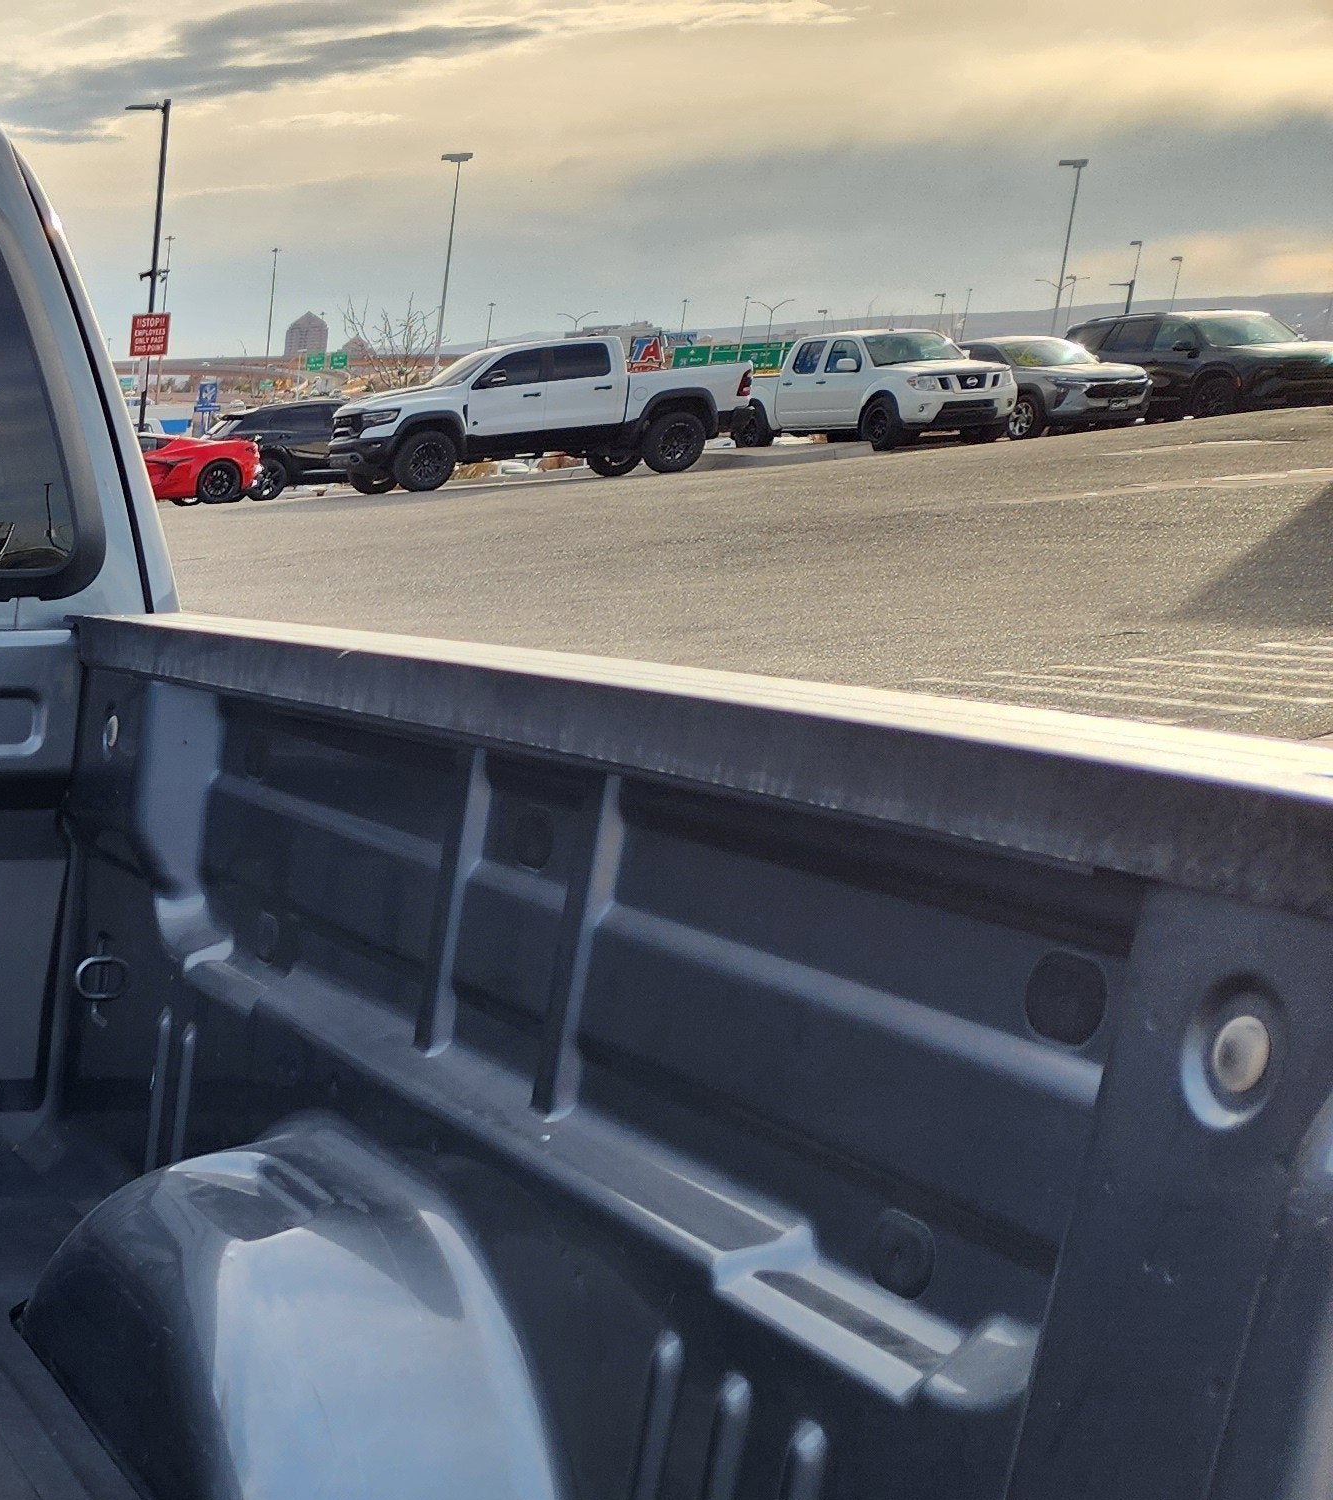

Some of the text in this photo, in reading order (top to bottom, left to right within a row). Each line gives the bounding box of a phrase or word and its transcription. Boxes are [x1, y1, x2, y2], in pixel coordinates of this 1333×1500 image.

[134, 328, 166, 337] EMPLOYEES
[134, 336, 164, 345] ONLY PAST
[147, 343, 164, 352] POINT
[631, 337, 662, 363] TA
